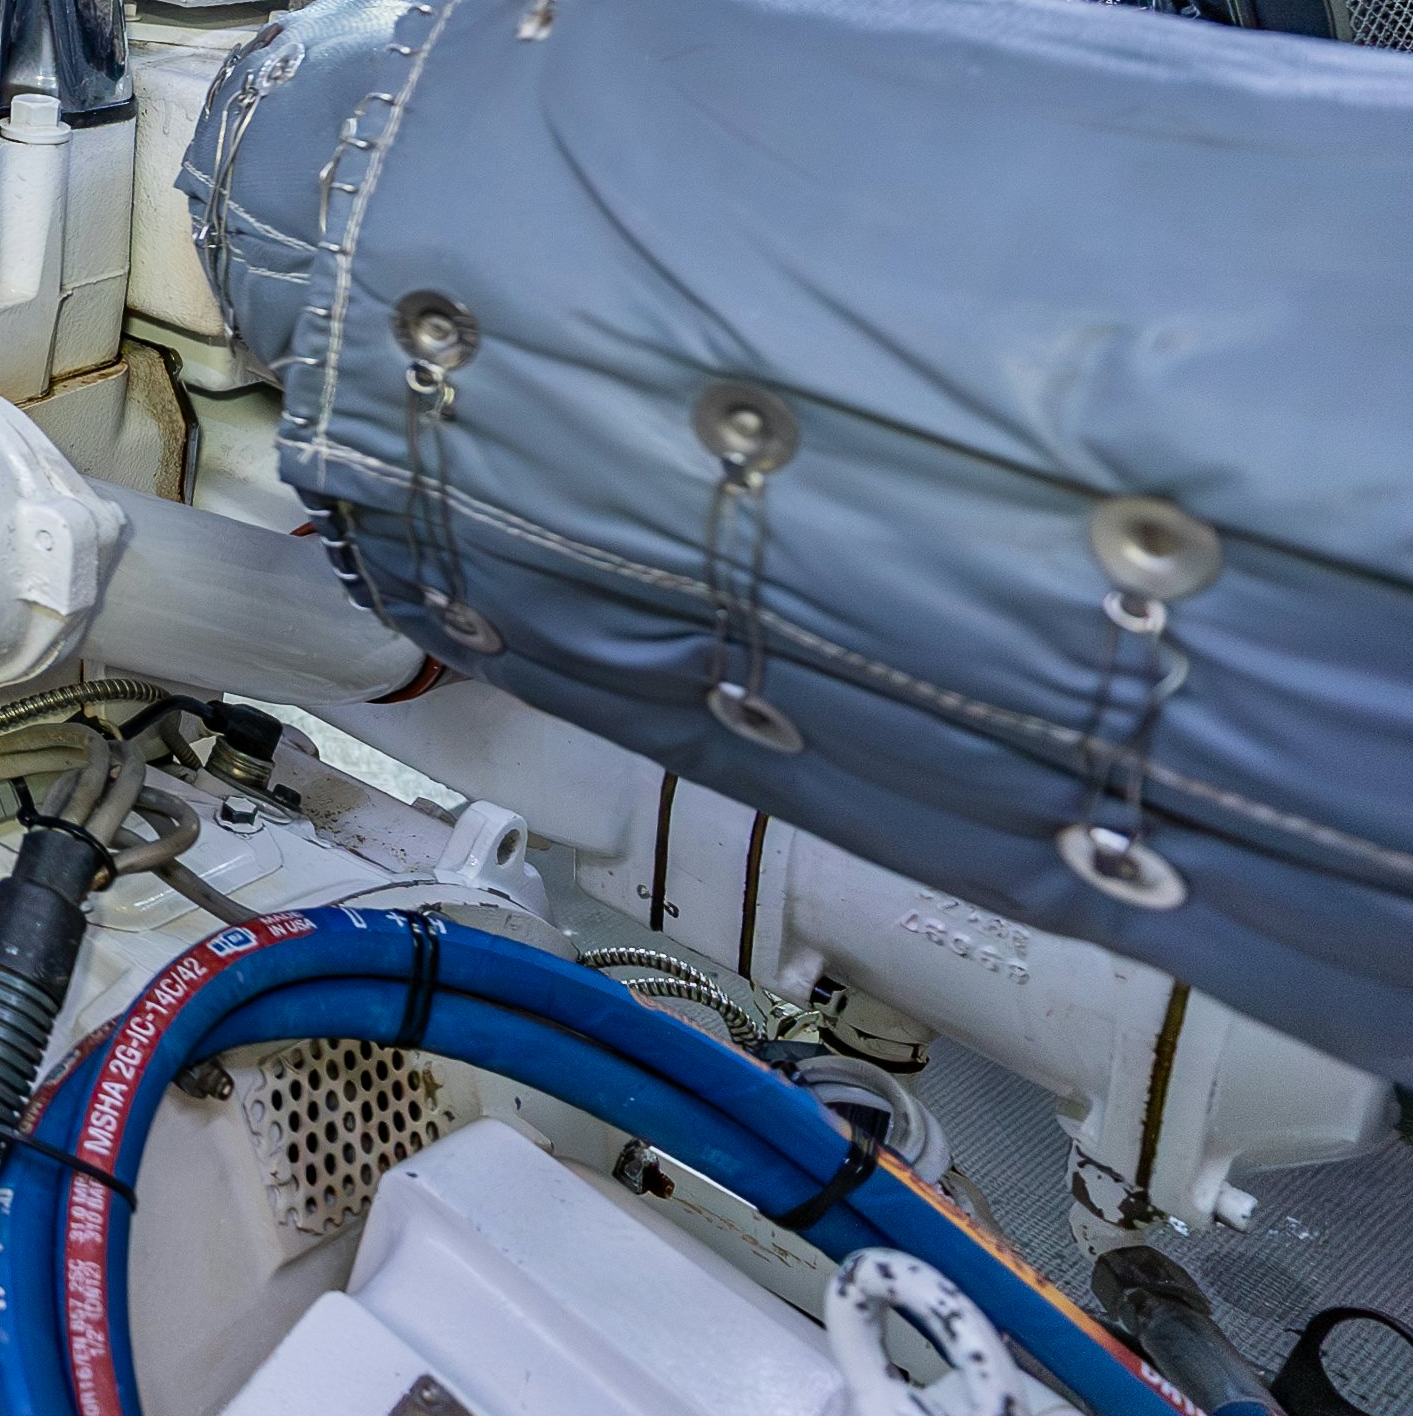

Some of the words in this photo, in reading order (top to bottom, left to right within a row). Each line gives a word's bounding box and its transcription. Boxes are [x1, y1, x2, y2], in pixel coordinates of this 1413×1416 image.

[266, 922, 286, 938] IN
[288, 915, 318, 934] USA
[83, 1080, 129, 1156] MSHA
[108, 956, 208, 1080] 2G-IC-14C/42
